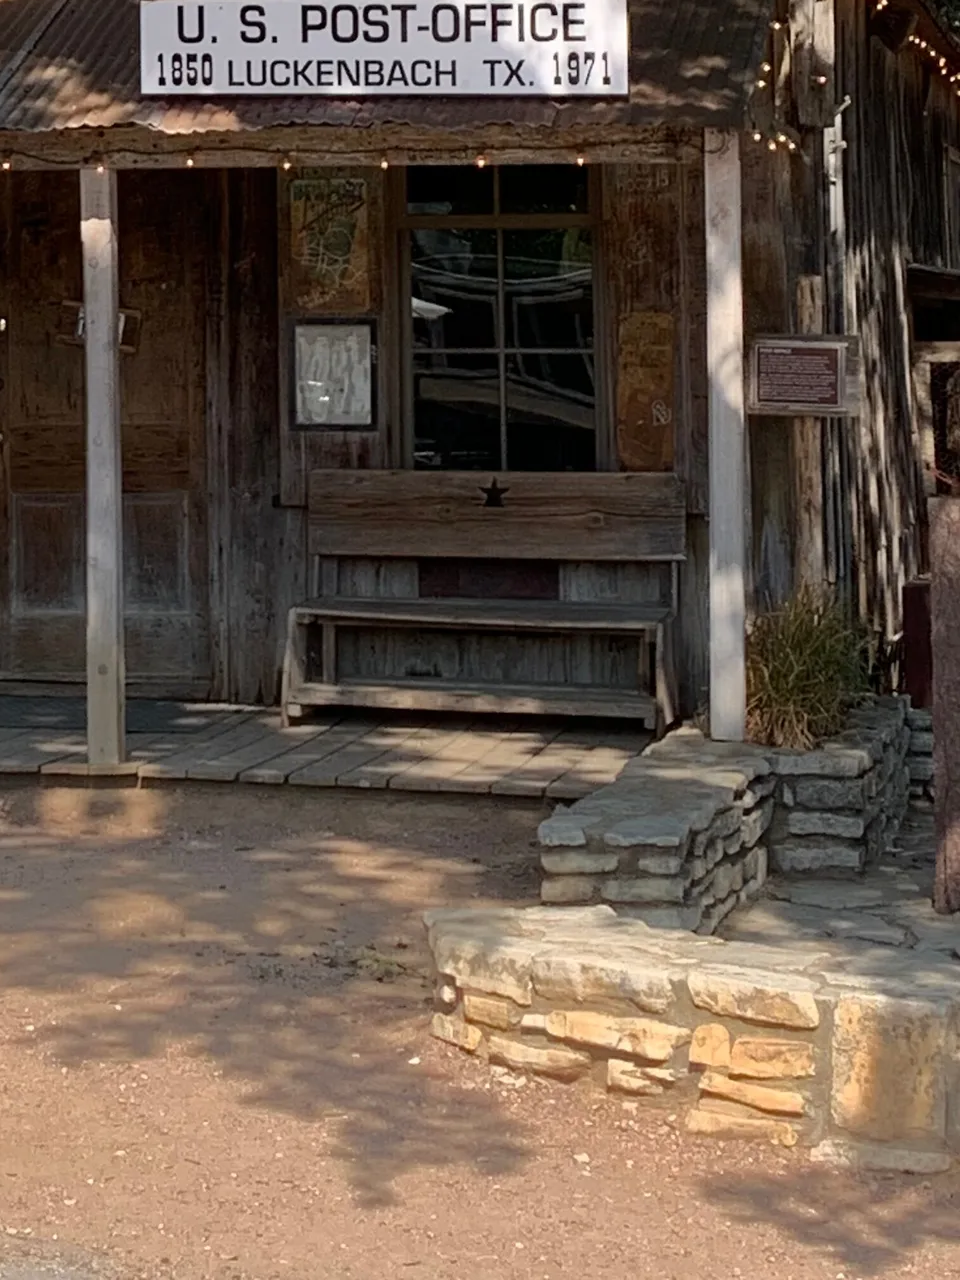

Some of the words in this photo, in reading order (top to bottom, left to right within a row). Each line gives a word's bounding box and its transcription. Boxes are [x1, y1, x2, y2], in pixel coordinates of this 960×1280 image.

[176, 4, 218, 44] U.
[239, 4, 278, 44] S.
[300, 2, 587, 44] POST-OFFICE
[157, 53, 213, 87] 1850
[227, 58, 458, 88] LUCKENBACH
[482, 58, 535, 87] TX.
[552, 51, 612, 86] 1971
